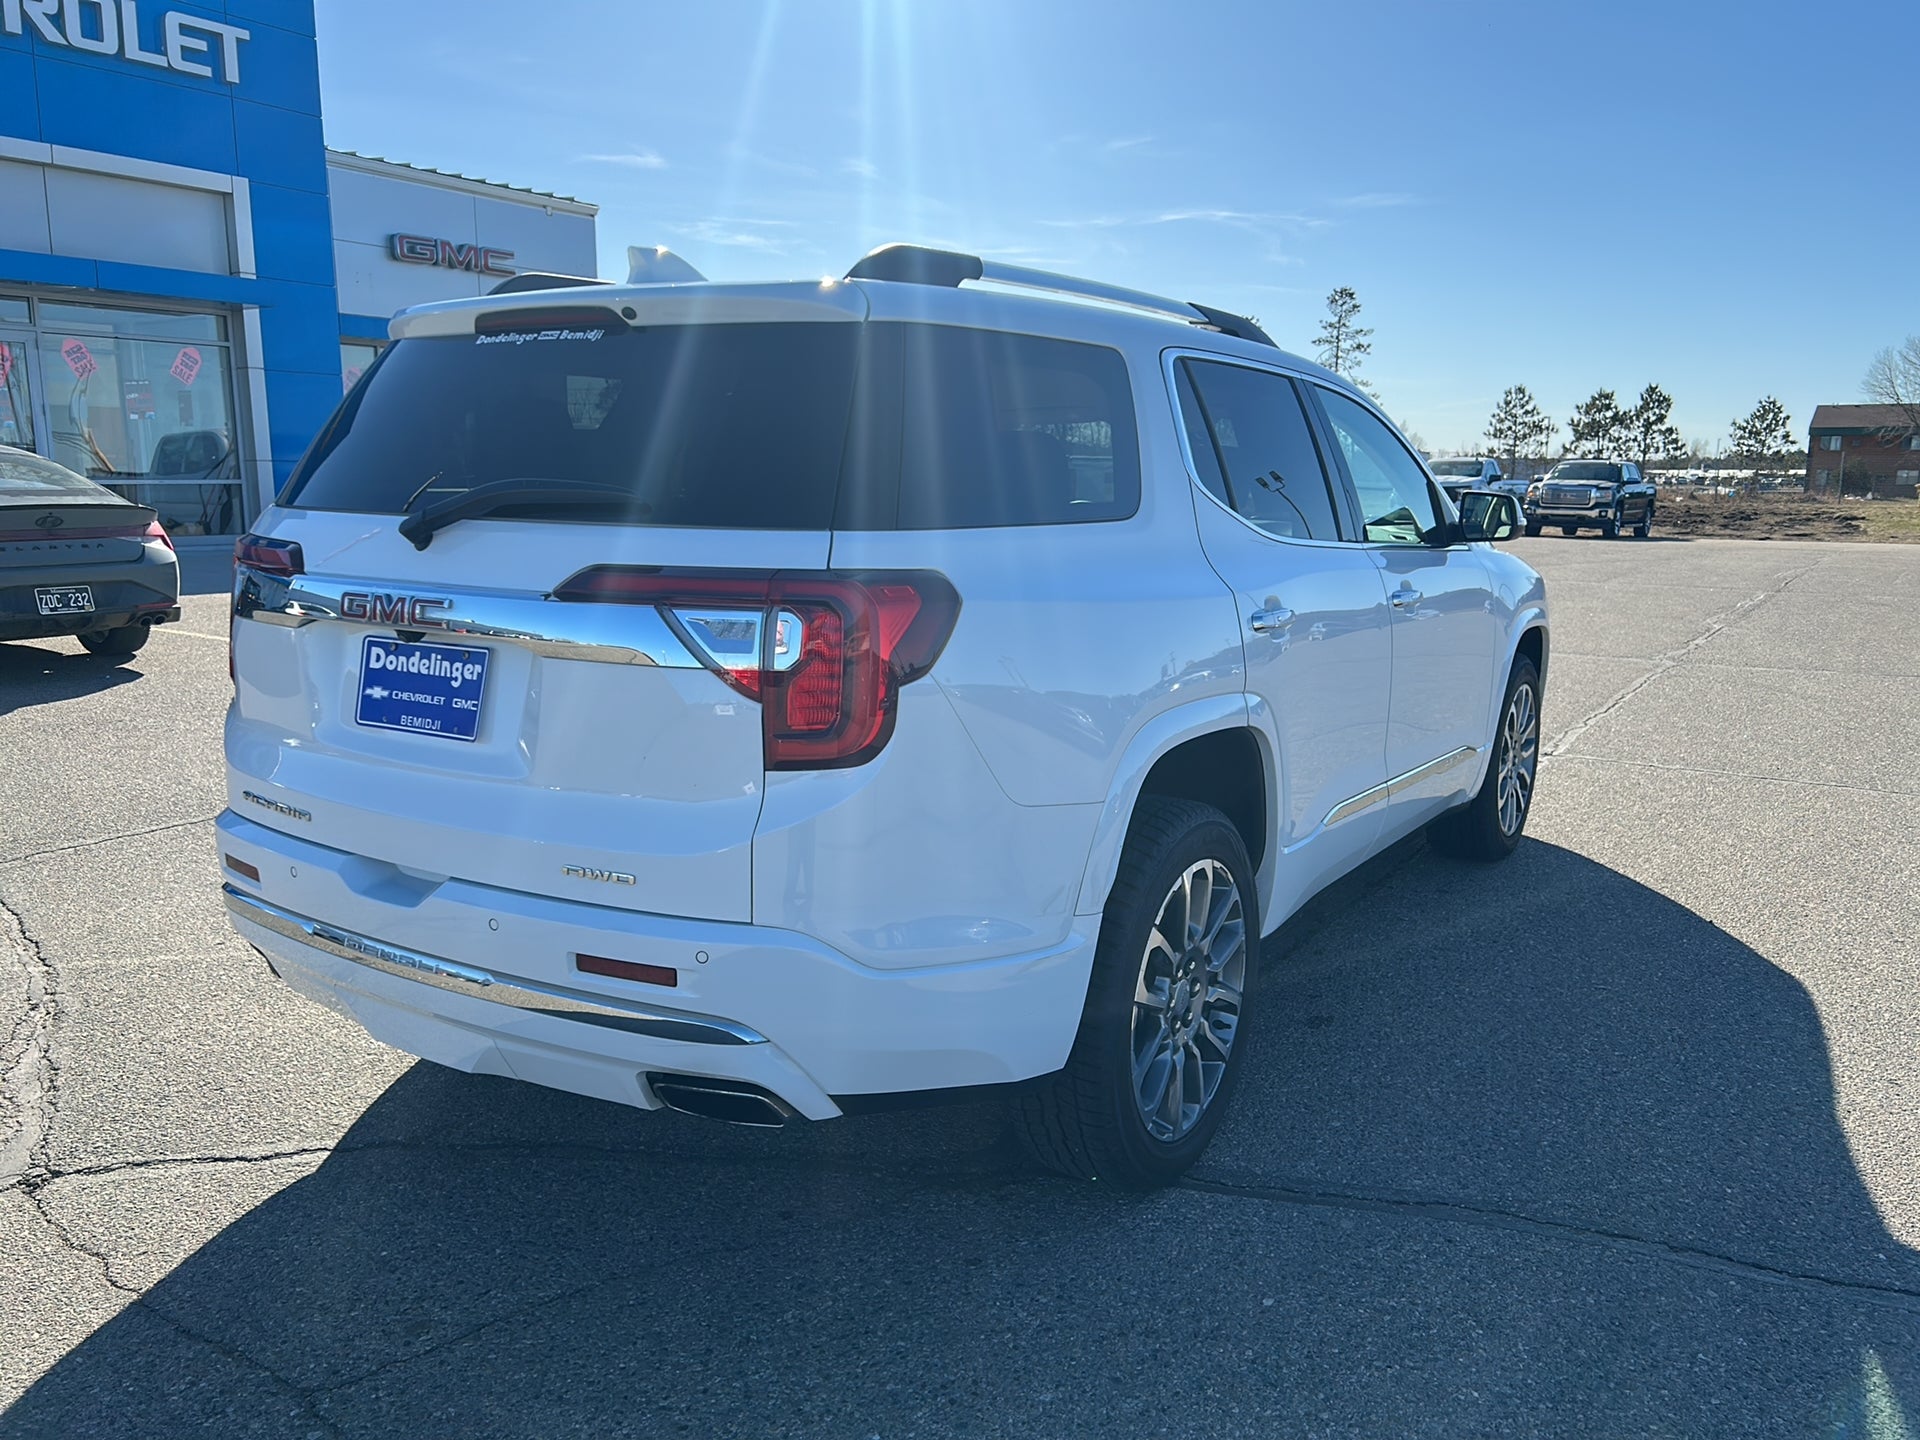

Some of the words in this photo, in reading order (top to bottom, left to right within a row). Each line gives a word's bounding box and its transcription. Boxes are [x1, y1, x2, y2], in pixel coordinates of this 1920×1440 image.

[392, 233, 517, 277] GMC
[475, 332, 539, 345] Dondelinger
[560, 329, 605, 341] Bemidji
[172, 365, 194, 384] SALE
[68, 592, 90, 606] 232
[340, 591, 452, 629] GMC
[369, 646, 482, 688] Dondelinger
[392, 690, 446, 705] CHEVROLET
[452, 698, 478, 711] GMC
[400, 715, 441, 730] BEMIDJI
[562, 864, 636, 885] AWD
